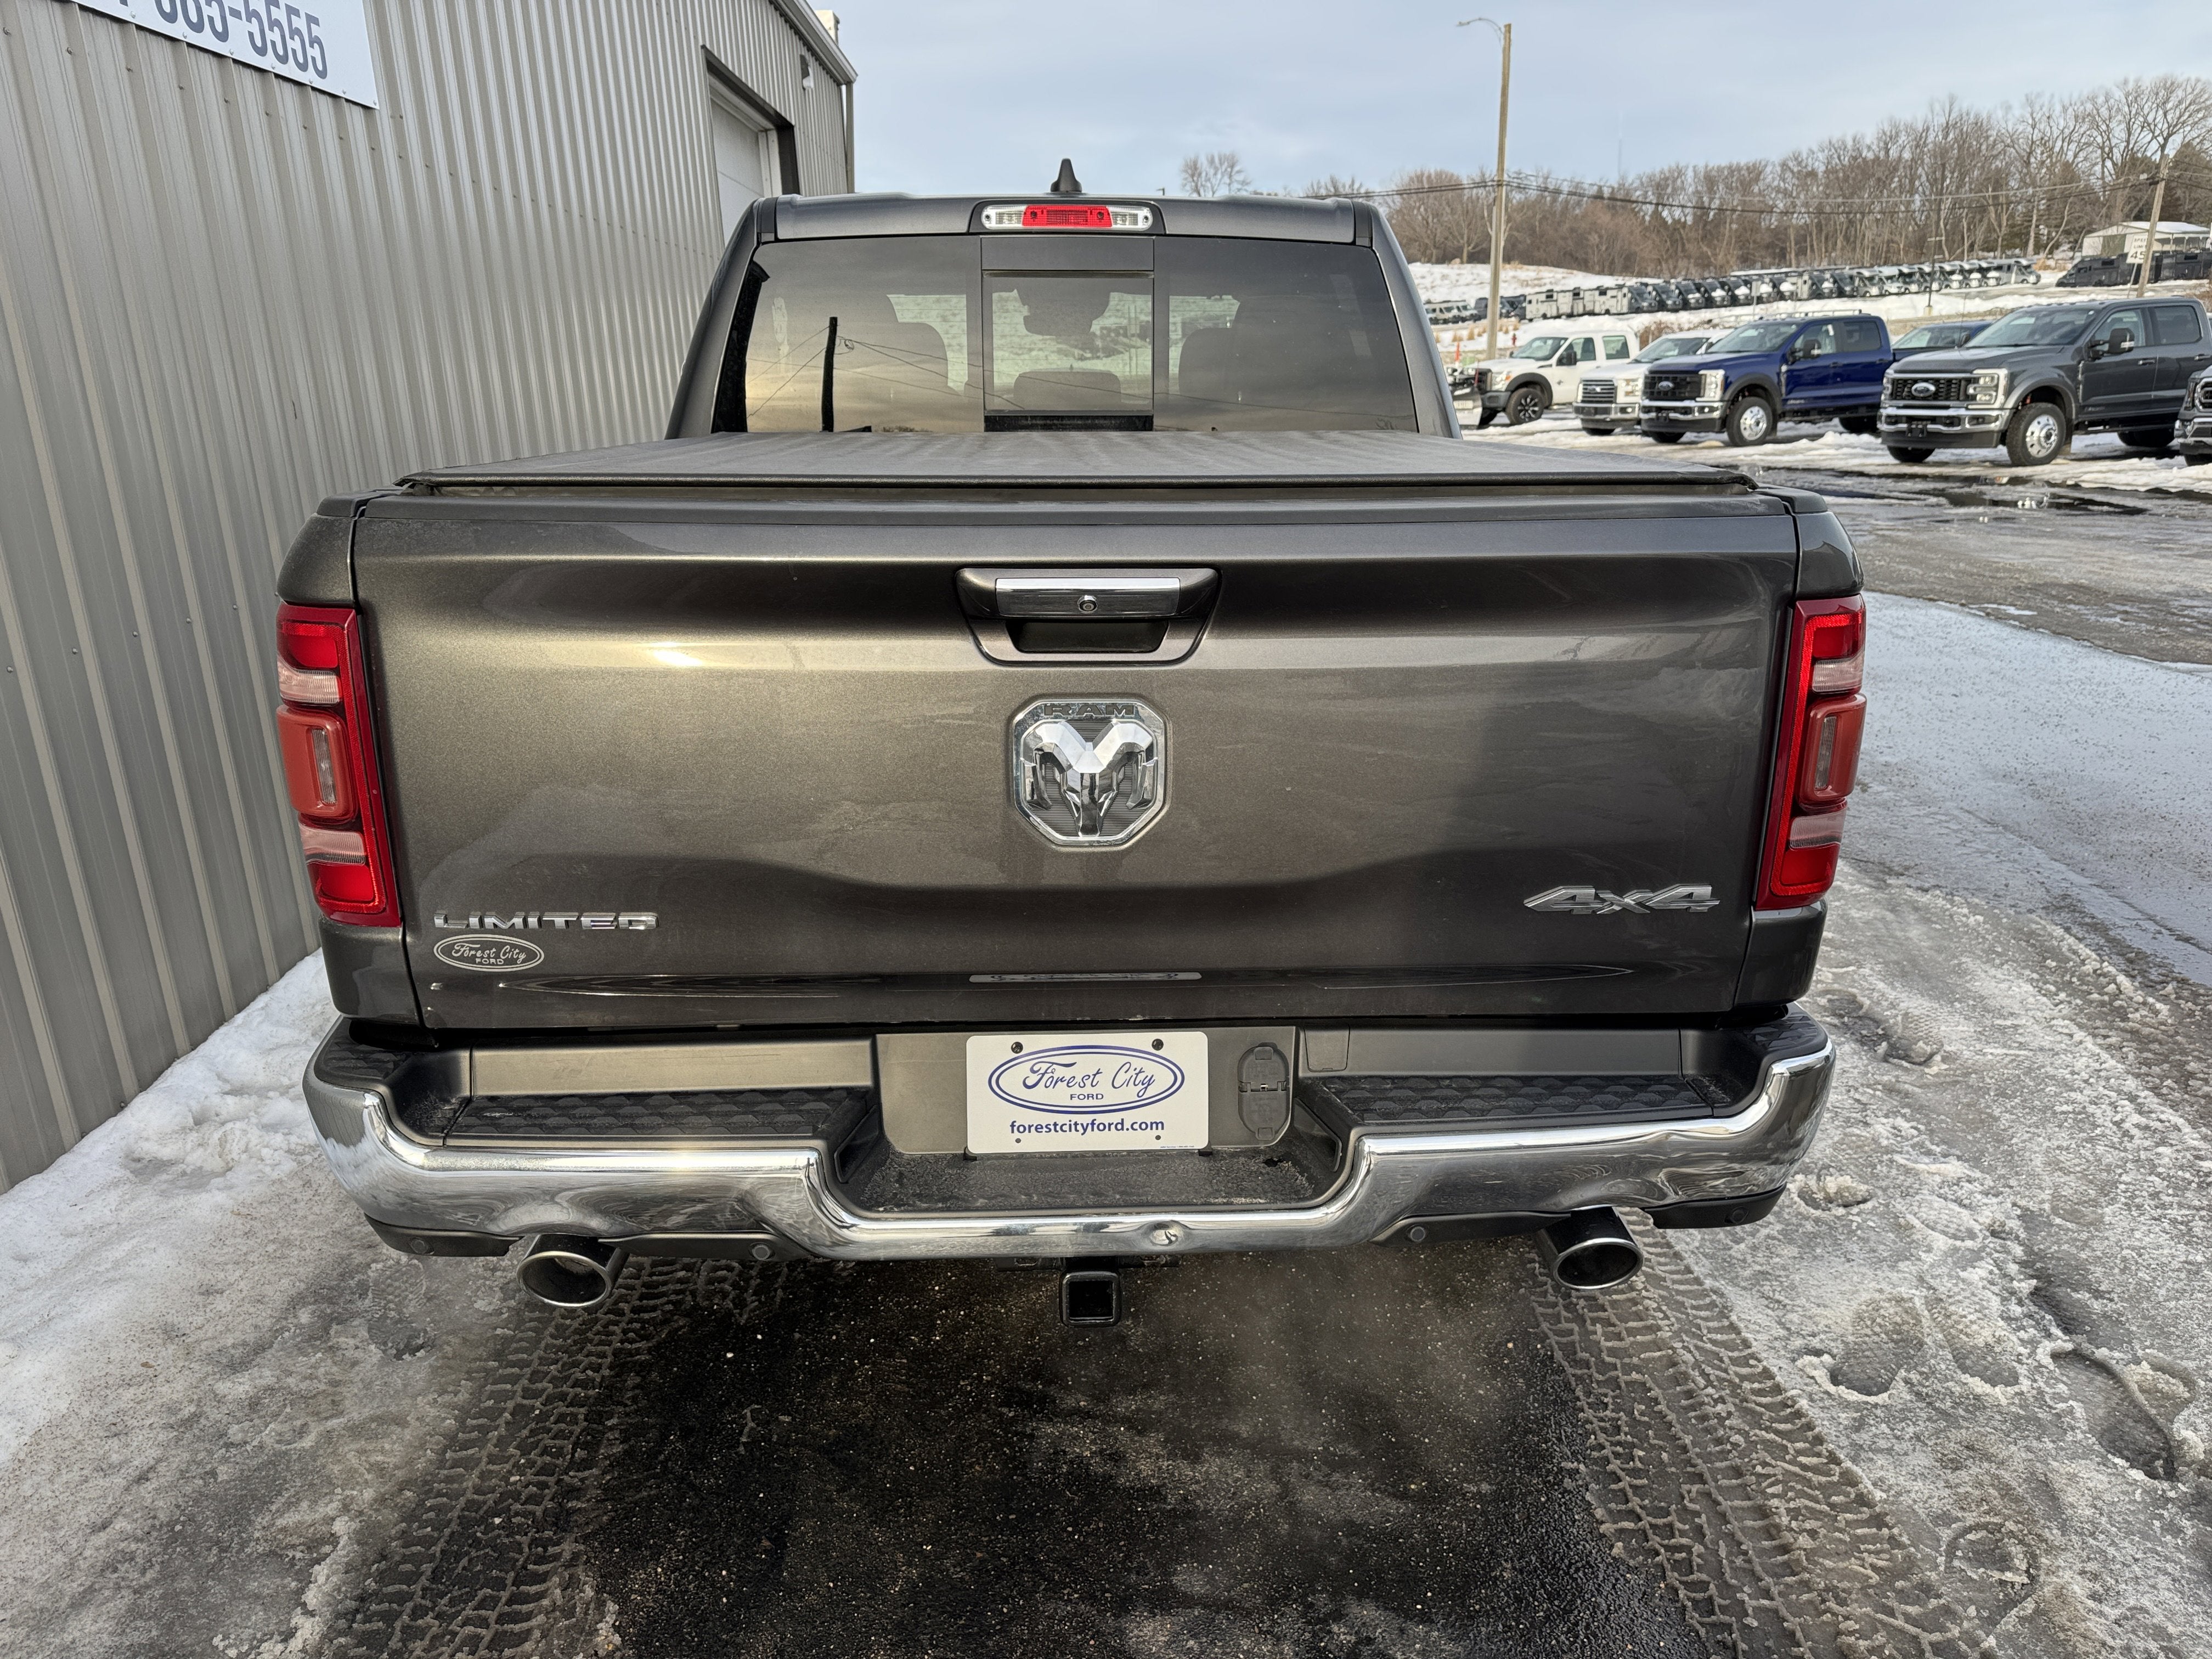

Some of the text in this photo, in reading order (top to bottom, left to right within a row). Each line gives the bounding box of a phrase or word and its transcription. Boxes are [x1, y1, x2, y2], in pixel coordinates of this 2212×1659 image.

[1043, 704, 1135, 716] RAM
[433, 911, 658, 930] LIMITED
[451, 942, 527, 963] Forest City
[1022, 1060, 1156, 1098] Forest City
[1009, 1118, 1165, 1136] forestcityford.com
